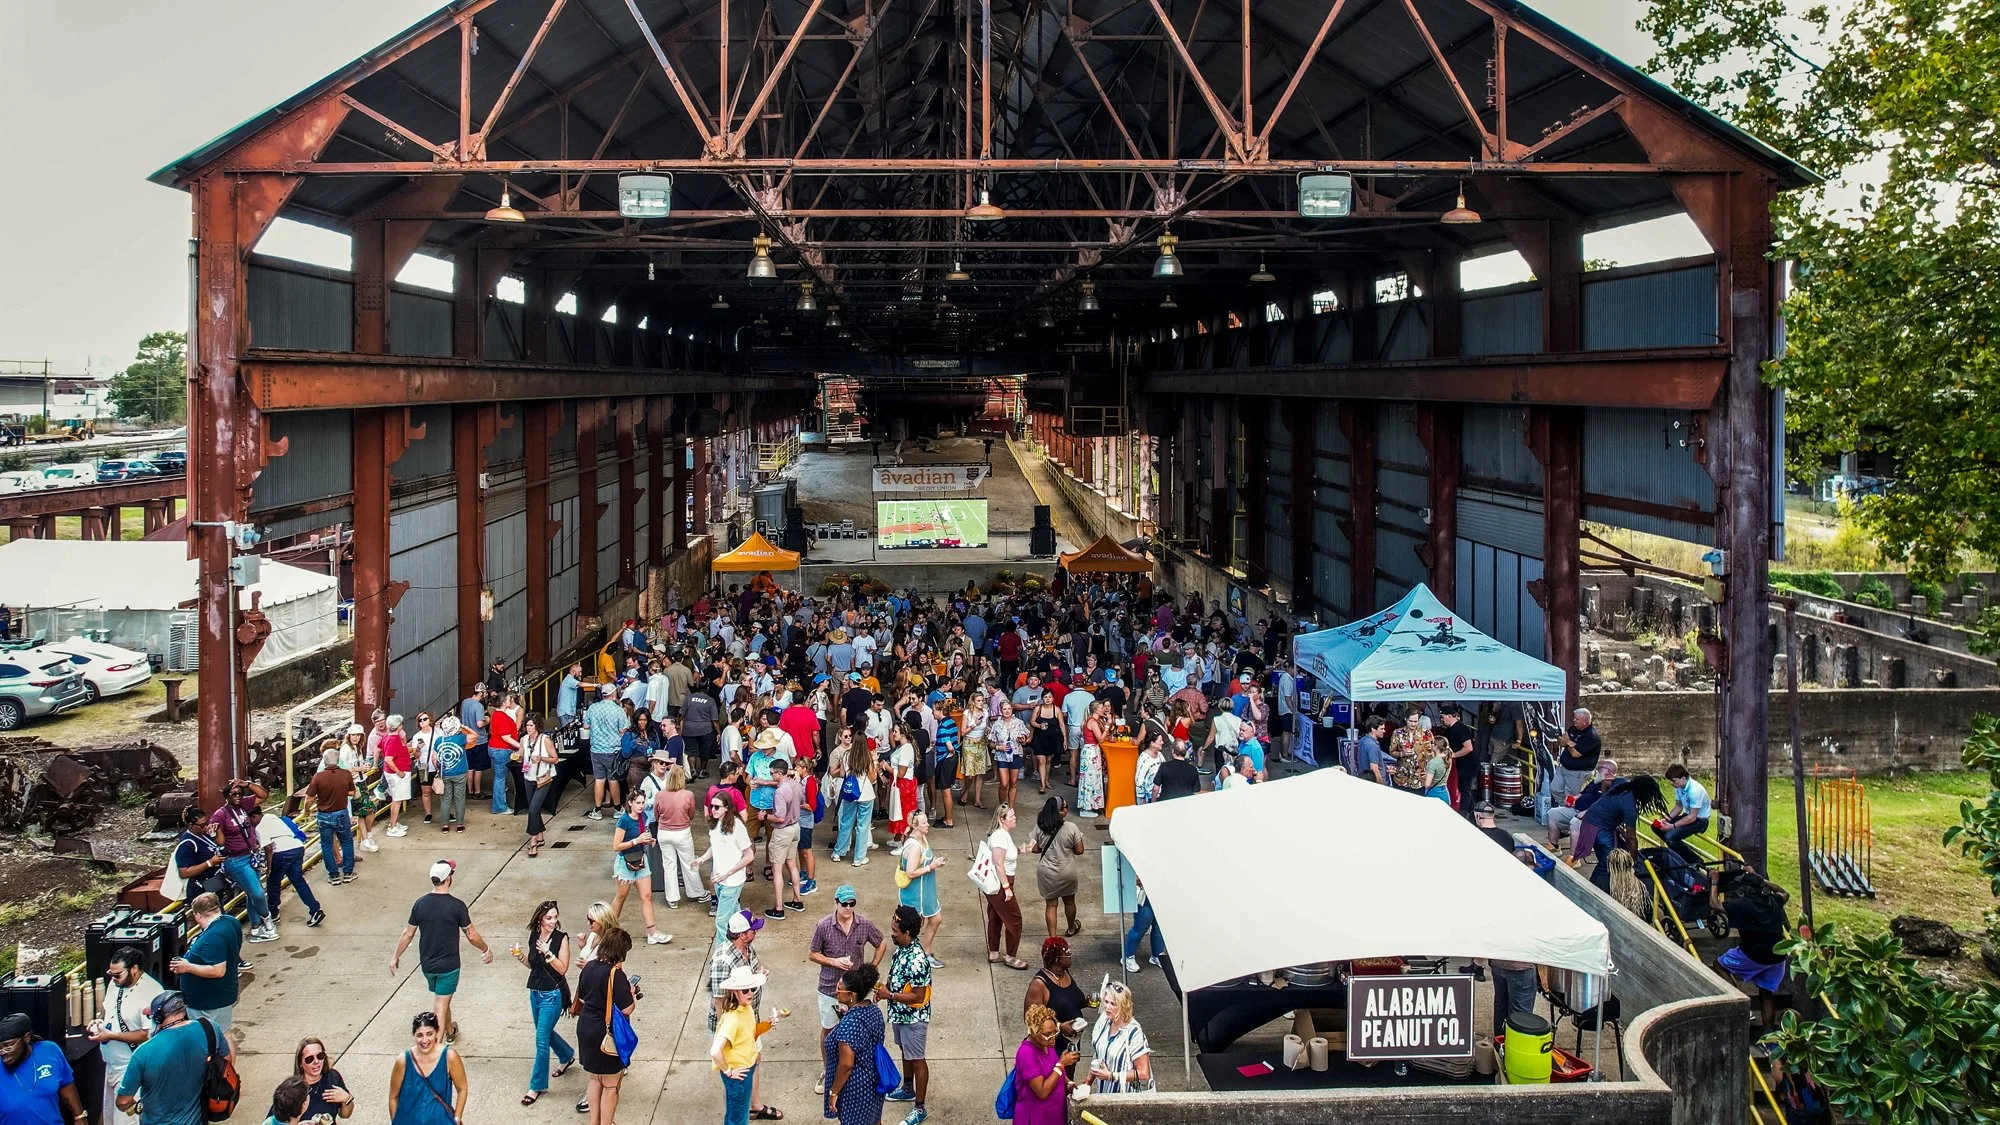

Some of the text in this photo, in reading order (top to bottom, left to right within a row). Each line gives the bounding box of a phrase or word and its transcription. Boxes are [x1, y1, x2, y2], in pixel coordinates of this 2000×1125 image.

[881, 468, 956, 484] âvadian
[1375, 679, 1449, 690] Save Water.
[1472, 679, 1541, 690] Drink Beer.
[1365, 986, 1457, 1016] ALABAMA
[1361, 1017, 1465, 1048] PEANUT CO.
